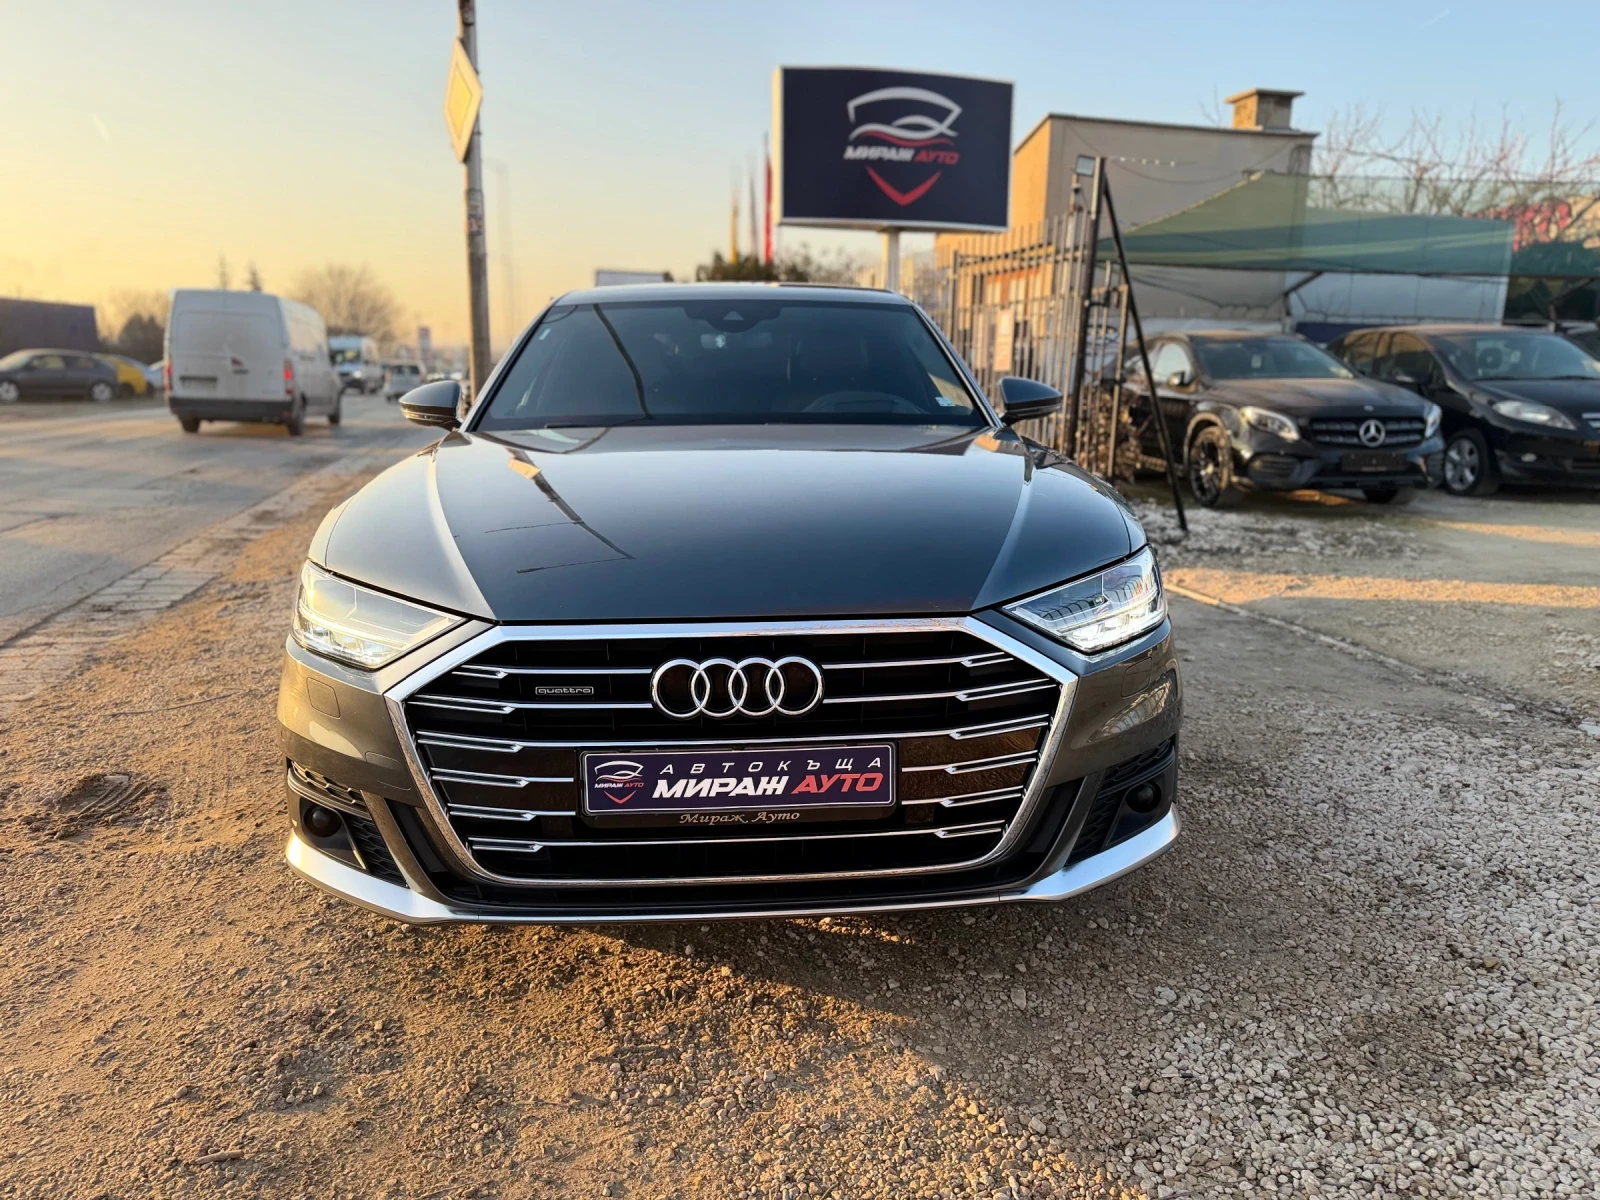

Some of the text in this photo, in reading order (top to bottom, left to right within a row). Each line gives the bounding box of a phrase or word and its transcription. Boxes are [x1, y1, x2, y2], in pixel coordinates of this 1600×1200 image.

[843, 145, 960, 165] МИРАЖ АУТО
[538, 687, 591, 695] quattro
[652, 772, 883, 798] МИРАЖ АУТО
[679, 811, 800, 826] Мираж Ауто
